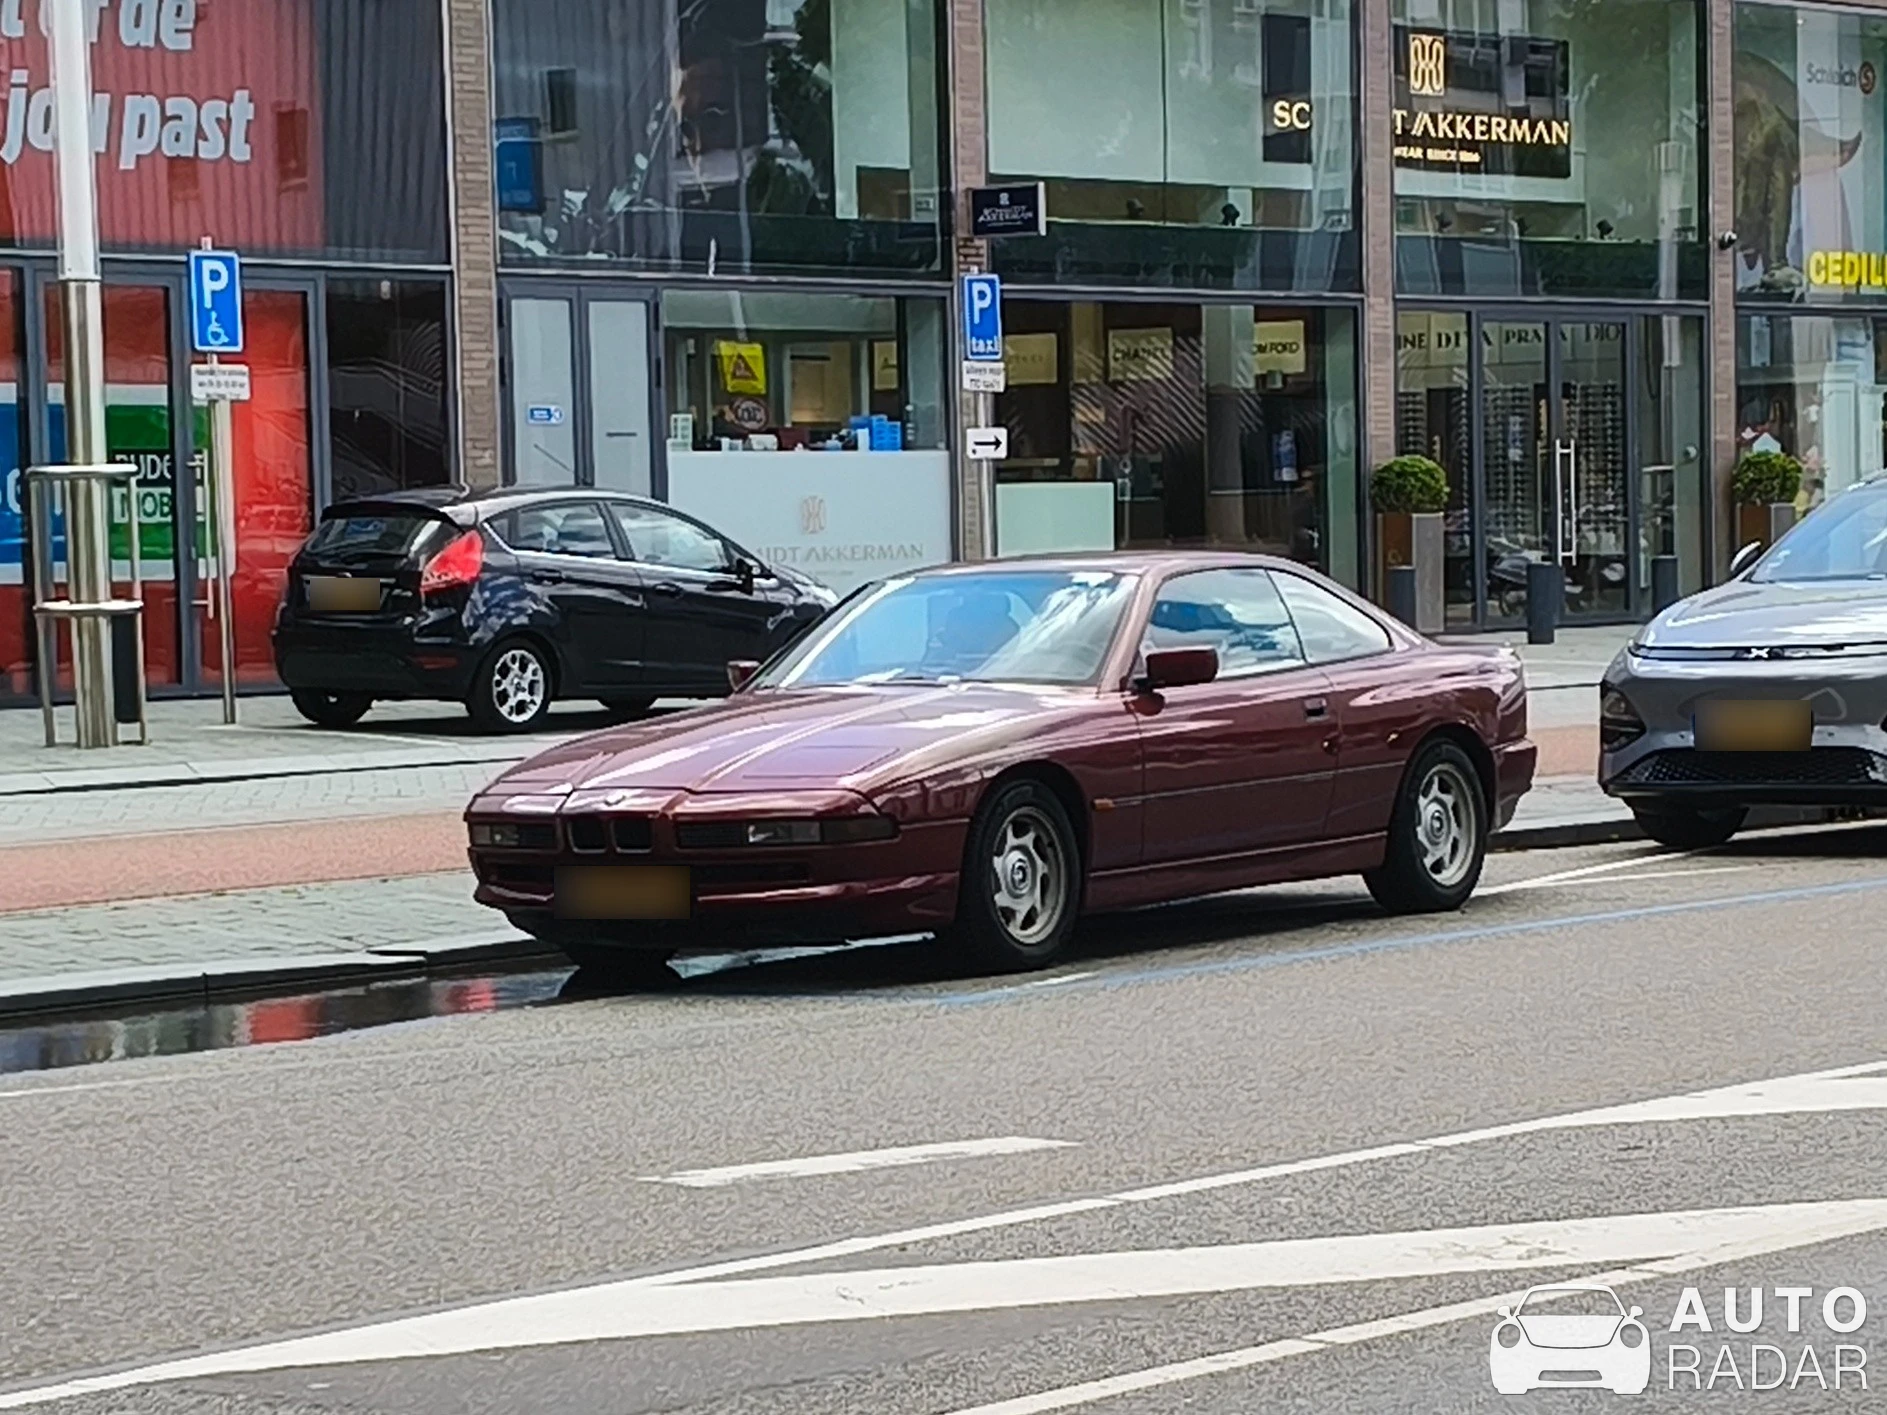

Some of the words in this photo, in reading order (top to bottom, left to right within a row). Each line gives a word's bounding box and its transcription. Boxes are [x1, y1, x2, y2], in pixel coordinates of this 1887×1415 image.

[119, 89, 254, 170] past
[1393, 109, 1407, 135] T
[1411, 111, 1570, 145] AKKERMAN
[203, 260, 228, 308] P
[1809, 251, 1887, 286] CEDIL
[972, 282, 992, 324] P
[971, 335, 1000, 354] taxi
[1585, 323, 1622, 342] DIO
[758, 547, 800, 563] IDT
[803, 543, 924, 563] AKKERMAN
